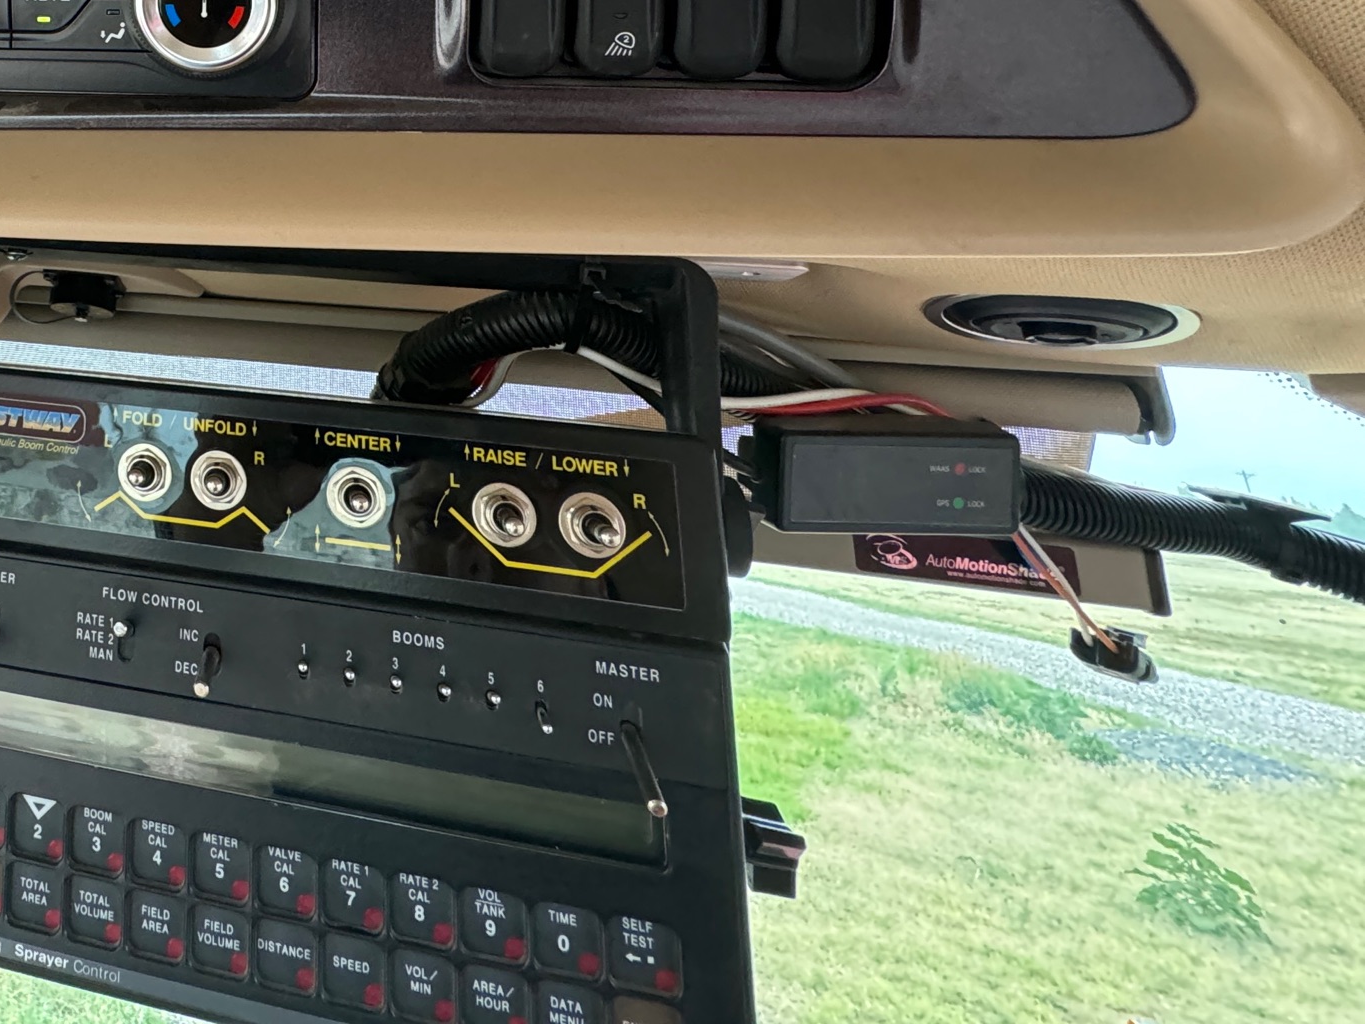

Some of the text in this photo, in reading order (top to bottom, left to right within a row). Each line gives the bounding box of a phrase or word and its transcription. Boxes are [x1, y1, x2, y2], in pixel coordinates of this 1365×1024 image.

[122, 409, 163, 428] FOLD
[183, 416, 247, 437] UNFOLD
[18, 439, 44, 451] Boom
[46, 441, 79, 455] Control
[104, 433, 113, 448] L
[323, 431, 391, 453] CENTER
[254, 451, 265, 466] R
[473, 446, 526, 467] RAISE
[551, 455, 618, 477] LOWER
[929, 465, 986, 474] WAAS LOCK
[449, 472, 460, 488] L
[633, 492, 646, 510] R
[936, 499, 985, 508] GPS LOCK
[102, 586, 204, 613] FLOW CONTROL
[76, 611, 114, 629] RATE 1
[75, 628, 114, 646] RATE 2
[179, 627, 199, 642] INC
[392, 629, 445, 651] BOOMS
[89, 646, 113, 662] MAN
[301, 642, 306, 655] 1
[346, 649, 352, 663] 2
[175, 660, 198, 676] DEC
[392, 657, 399, 670] 3
[439, 664, 446, 677] 4
[595, 660, 660, 684] MASTER
[487, 672, 494, 685] 5
[536, 679, 544, 693] 6
[593, 692, 613, 708] ON
[587, 728, 615, 745] OFF
[83, 807, 113, 824] BOOM
[33, 824, 43, 840] 2
[87, 821, 107, 836] CAL
[141, 819, 175, 836] SPEED
[92, 837, 101, 853] 3
[148, 833, 167, 849] CAL
[203, 832, 238, 850] METER
[152, 850, 161, 866] 4
[210, 846, 231, 862] CAL
[267, 845, 303, 863] VALVE
[215, 863, 224, 879] 5
[274, 859, 295, 876] CAL
[332, 858, 370, 877] RATE 1
[20, 876, 51, 894] TOTAL
[279, 876, 290, 893] 6
[340, 874, 362, 890] CAL
[399, 872, 439, 891] RATE 2
[21, 890, 47, 907] AREA
[79, 890, 110, 907] TOTAL
[345, 890, 356, 907] 7
[408, 888, 431, 905] CAL
[478, 887, 502, 904] VOL
[73, 904, 115, 922] VOLUME
[140, 904, 171, 922] FIELD
[414, 904, 425, 922] 8
[474, 901, 505, 919] TANK
[548, 909, 577, 927] TIME
[141, 918, 169, 935] AREA
[203, 919, 234, 936] FIELD
[485, 919, 496, 937] 9
[621, 916, 653, 934] SELF
[197, 932, 240, 952] VOLUME
[557, 934, 569, 952] 0
[622, 932, 655, 950] TEST
[257, 938, 311, 962] DISTANCE
[14, 943, 70, 972] Sprayer
[73, 959, 121, 984] Control
[332, 955, 370, 975] SPEED
[405, 963, 438, 982] VOL/
[410, 979, 432, 996] MIN
[472, 979, 514, 998] AREA/
[476, 995, 510, 1014] HOUR
[550, 996, 583, 1015] DATA
[549, 1011, 584, 1024] MENU
